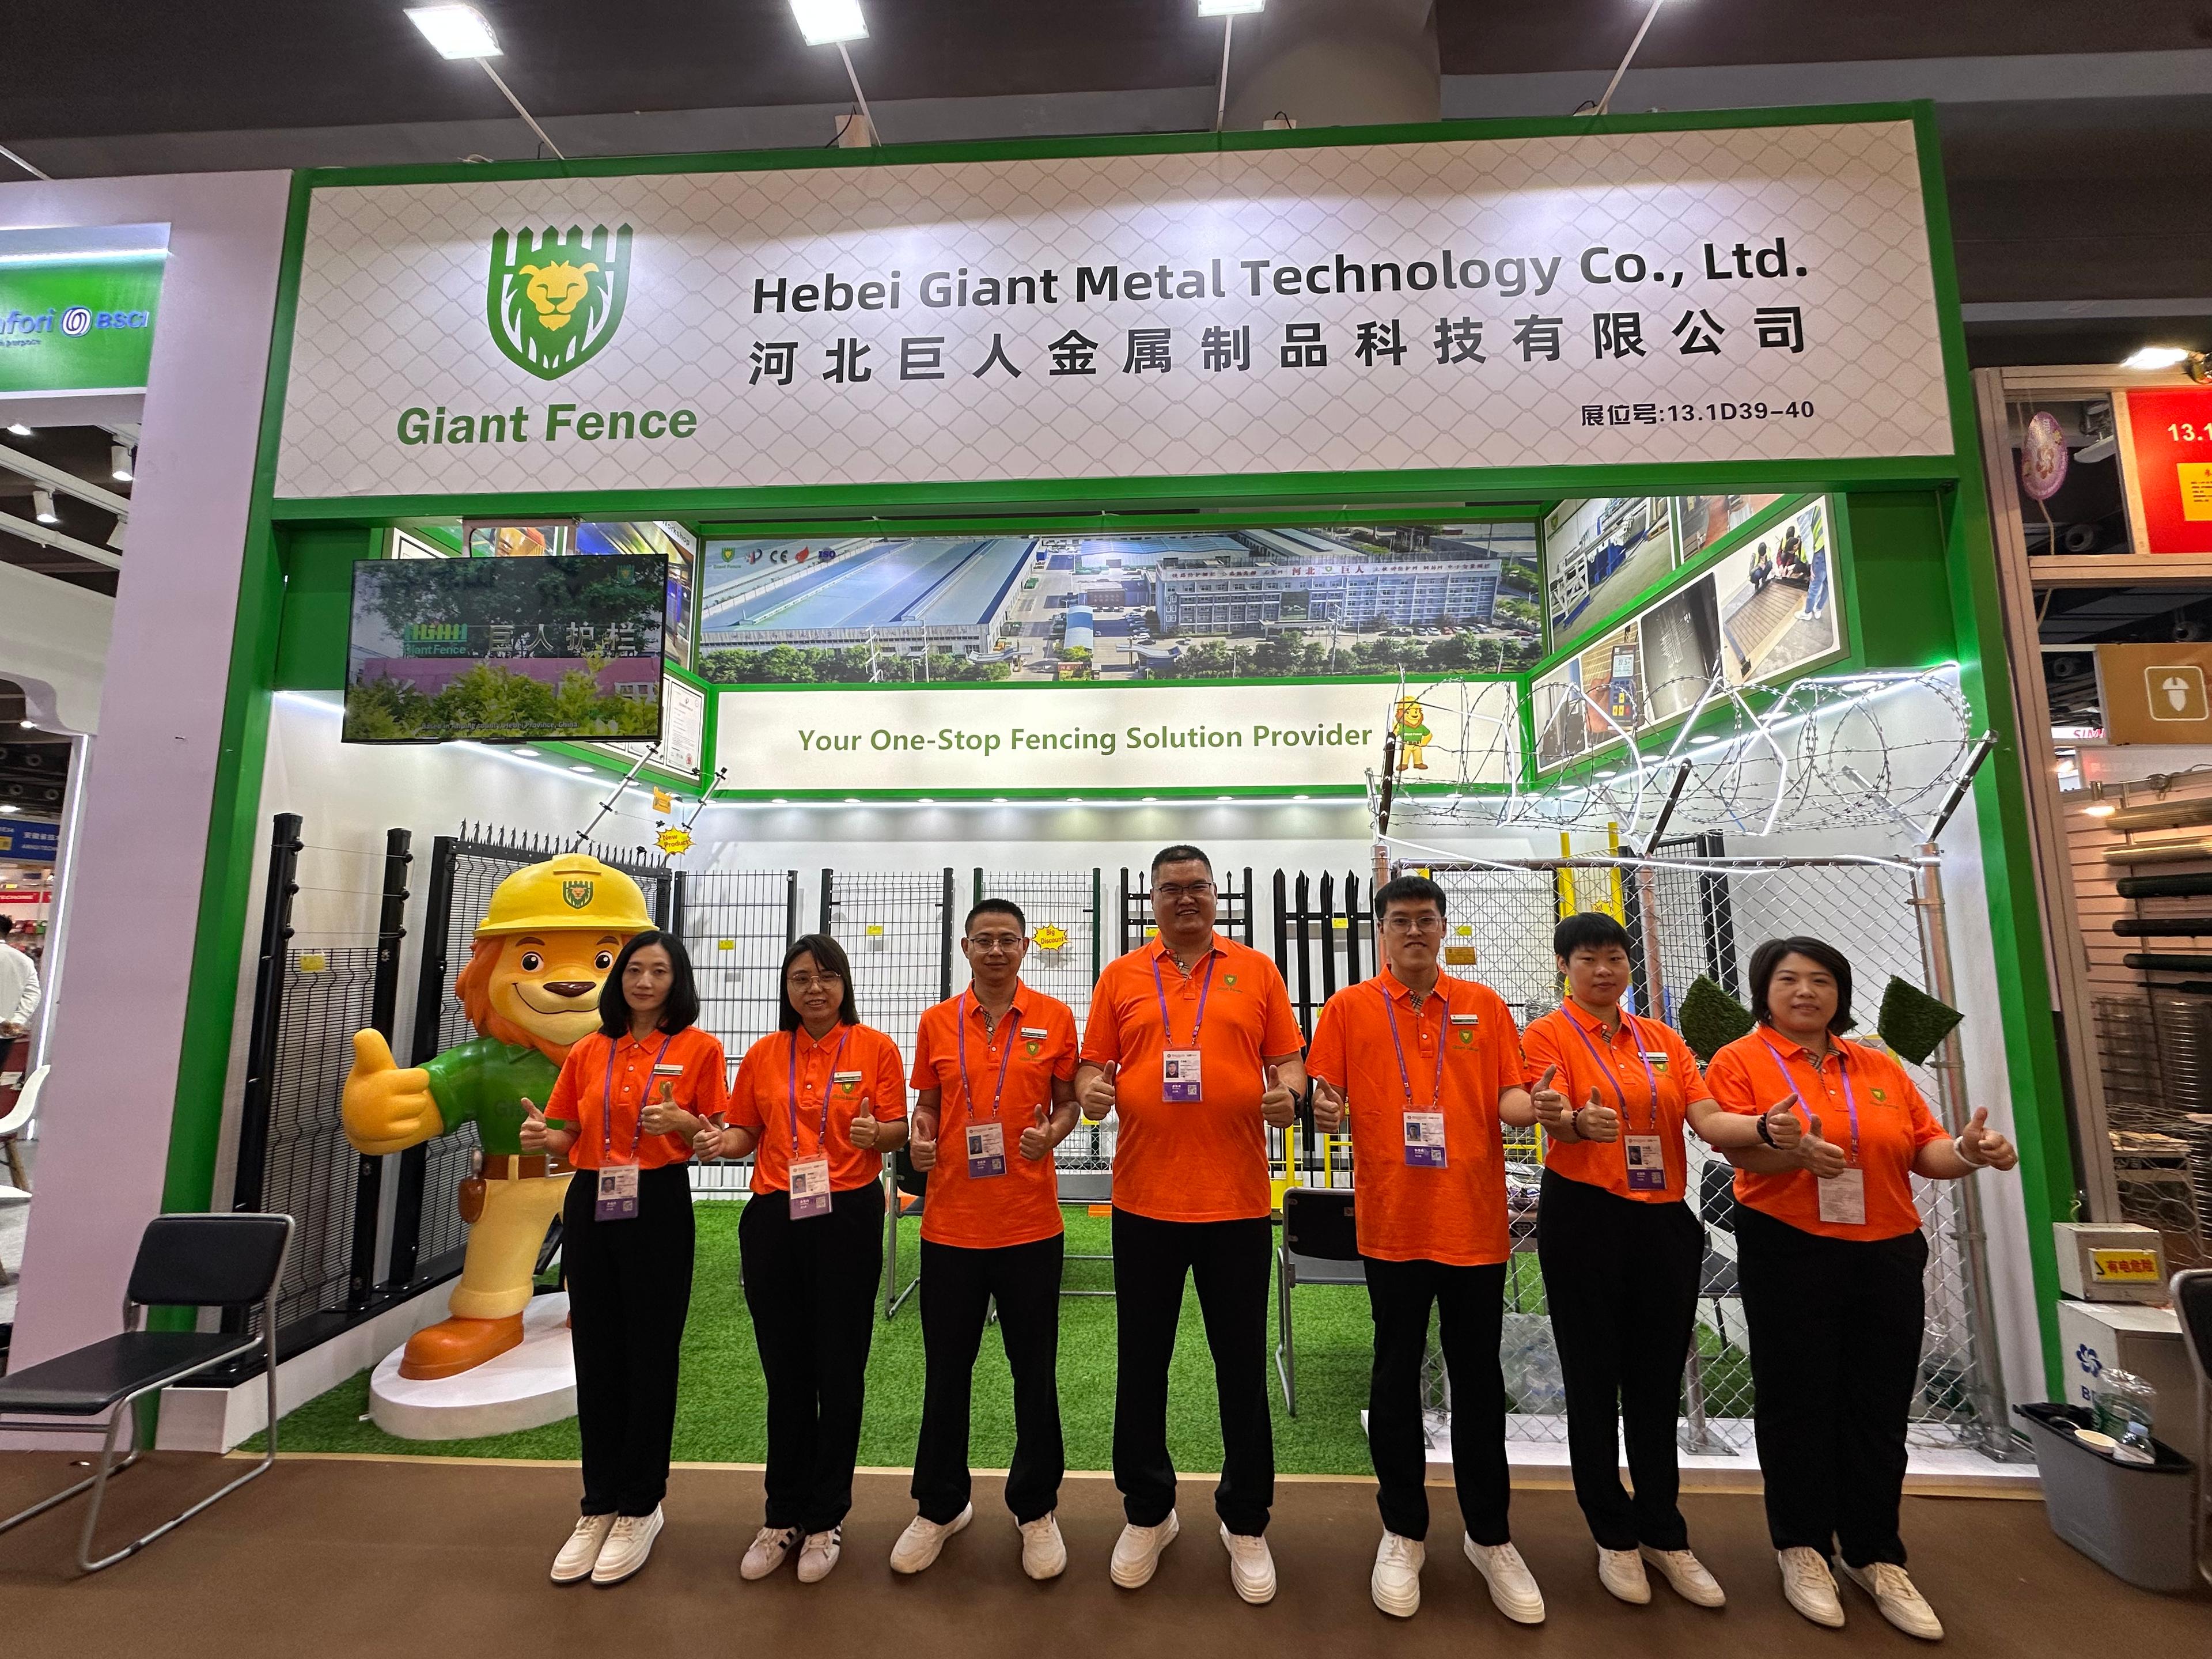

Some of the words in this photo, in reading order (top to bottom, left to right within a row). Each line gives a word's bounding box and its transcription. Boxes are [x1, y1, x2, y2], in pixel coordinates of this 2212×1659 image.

[753, 270, 900, 314] Hebei
[919, 267, 1058, 308] Giant
[1075, 258, 1225, 302] Metal
[1241, 249, 1561, 297] Technology
[1580, 247, 1684, 289] Co.,
[1703, 237, 1808, 281] Ltd.
[96, 311, 150, 329] BSCI
[748, 306, 1805, 386] 河北巨人金属制品科技有限公司
[397, 406, 529, 445] Giant
[546, 403, 697, 441] Fence
[1581, 401, 1815, 426] 展位号:13.1D39-40
[1292, 566, 1315, 575] 河北
[1341, 565, 1364, 574] 巨人
[490, 621, 637, 653] 巨人护栏
[433, 645, 467, 654] Fence
[798, 729, 862, 751] Your
[870, 728, 1001, 756] One-Stop
[1011, 726, 1116, 756] Fencing
[1126, 725, 1244, 749] Solution
[1253, 722, 1373, 747] Provider
[1040, 936, 1064, 945] Discount
[1046, 929, 1055, 937] Big
[2106, 1259, 2155, 1273] 有电危险
